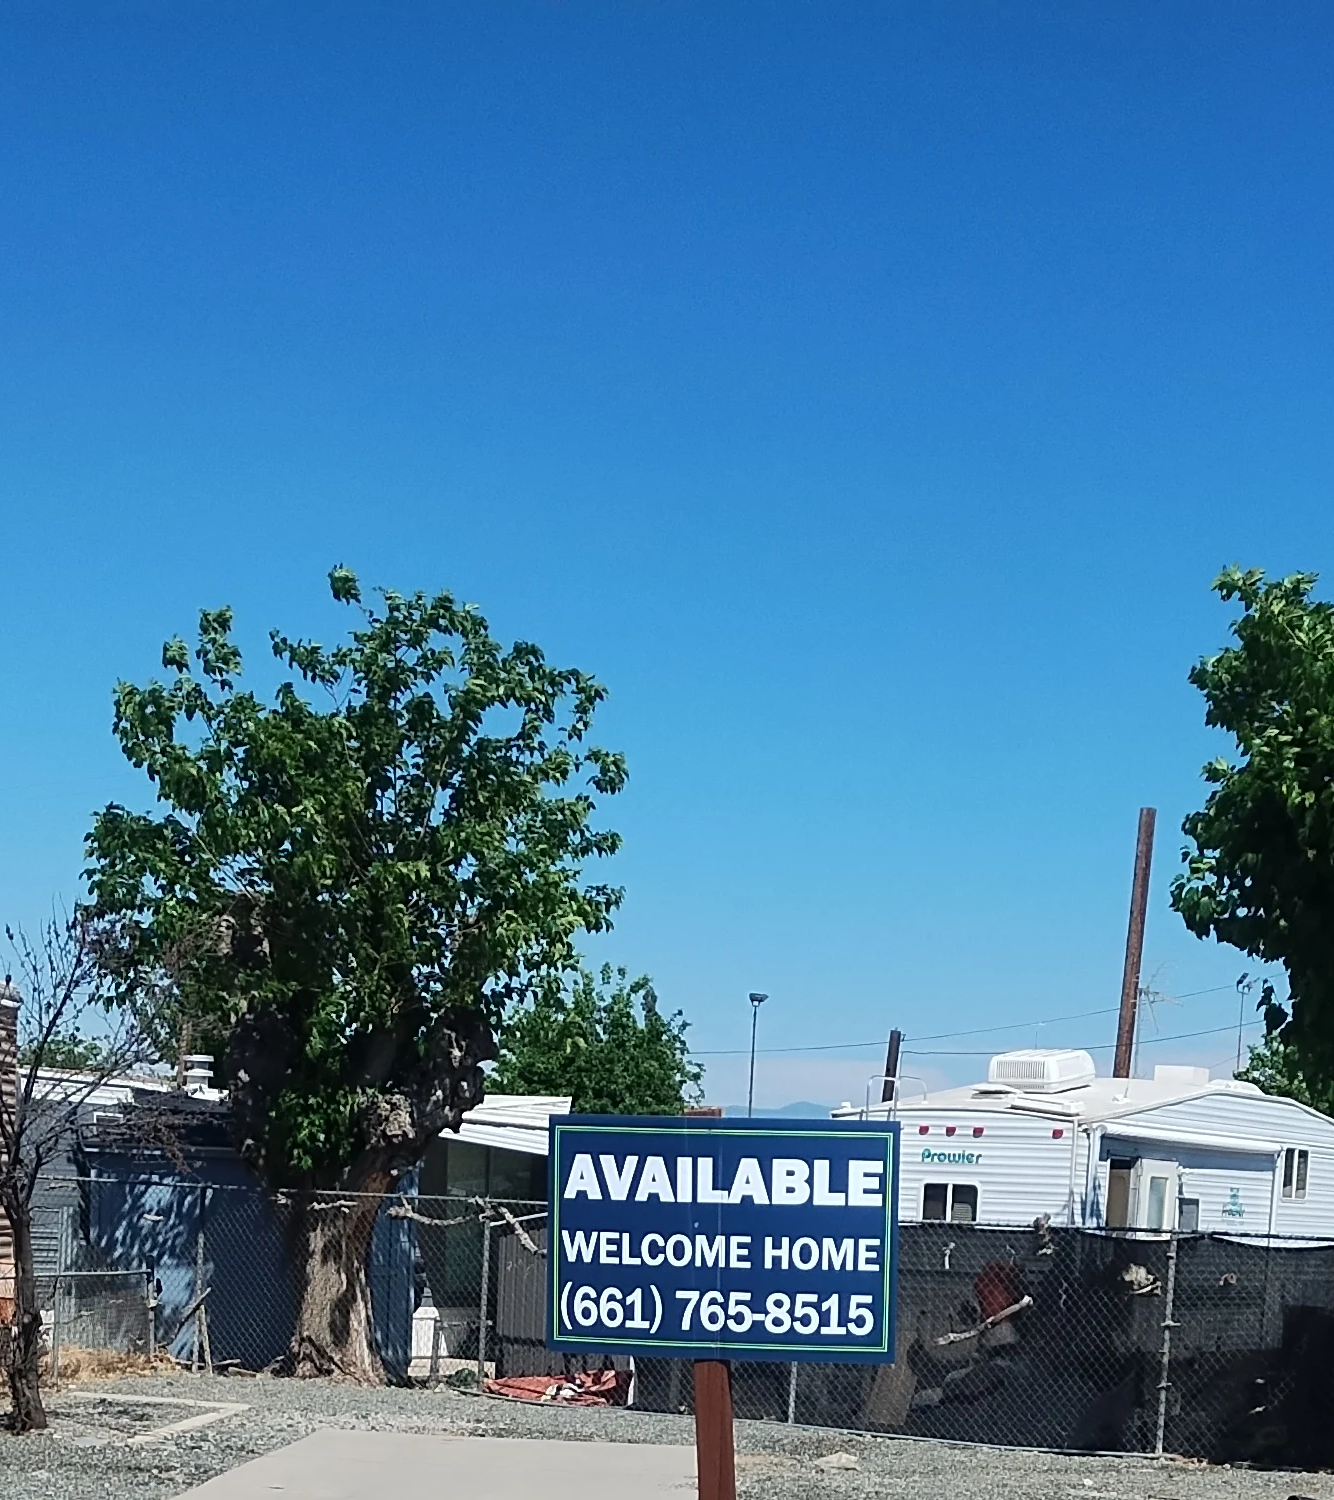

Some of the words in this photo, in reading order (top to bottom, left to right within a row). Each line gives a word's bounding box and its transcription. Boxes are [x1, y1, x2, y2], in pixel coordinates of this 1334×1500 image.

[563, 1153, 884, 1207] AVAILABLE
[921, 1148, 983, 1164] Prowler
[561, 1229, 752, 1269] WELCOME
[764, 1236, 881, 1272] HOME
[560, 1281, 663, 1334] (661)
[675, 1290, 874, 1336] 765-8515
